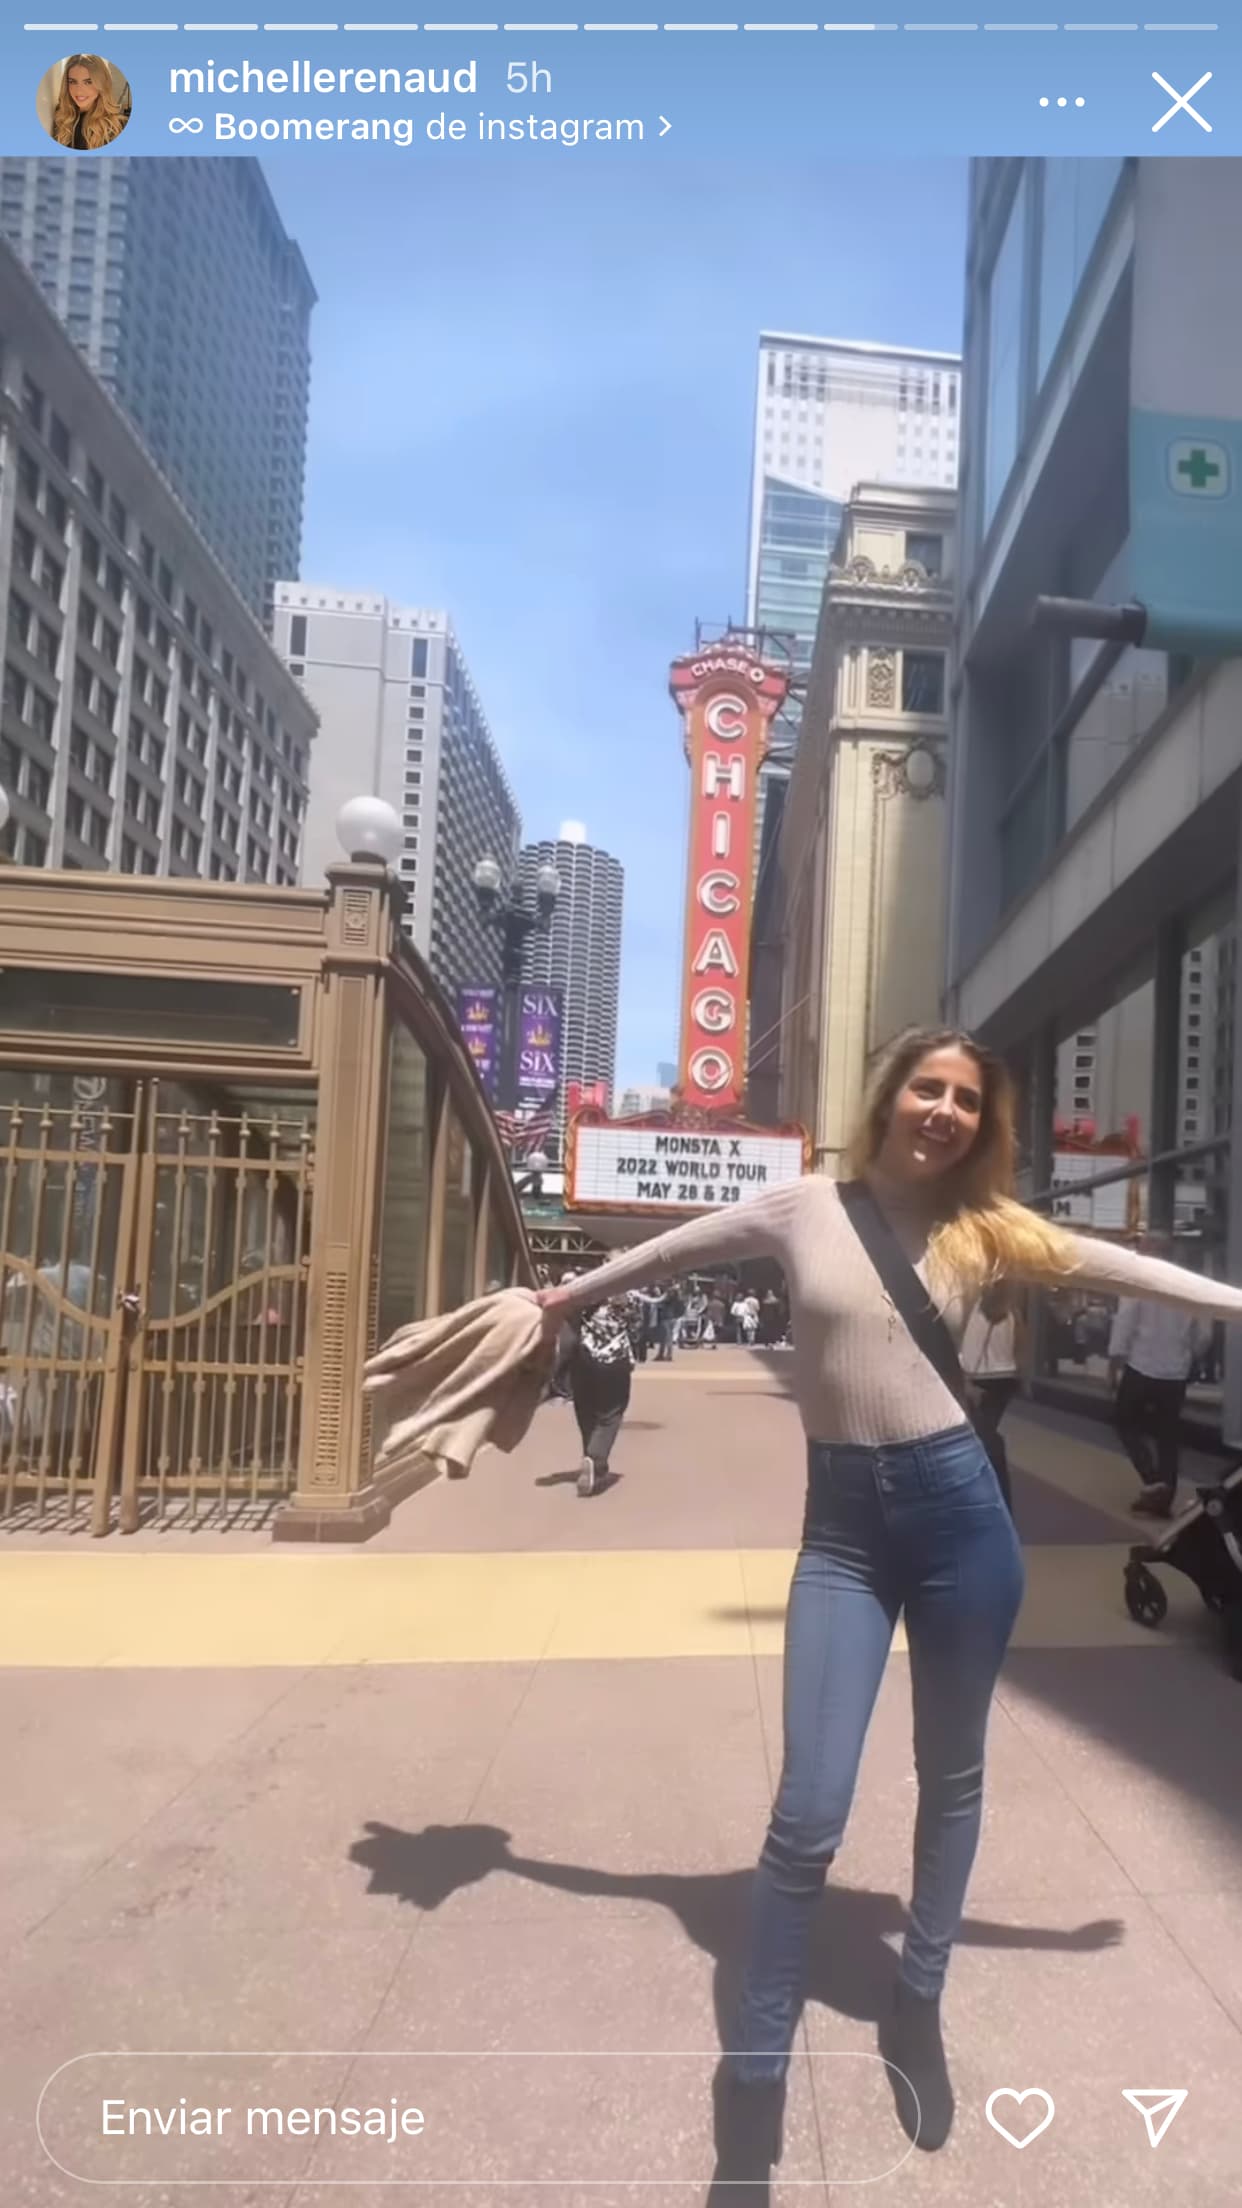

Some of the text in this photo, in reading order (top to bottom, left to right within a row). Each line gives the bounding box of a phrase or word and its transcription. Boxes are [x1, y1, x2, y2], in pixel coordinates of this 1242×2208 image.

[691, 658, 748, 676] CHASE
[688, 693, 747, 1091] CHICAGO
[655, 1136, 741, 1157] MONSTA X
[616, 1157, 767, 1182] 2022 WORLD TOUR
[637, 1182, 671, 1199] MAY
[678, 1184, 698, 1200] 28
[721, 1186, 740, 1202] 29
